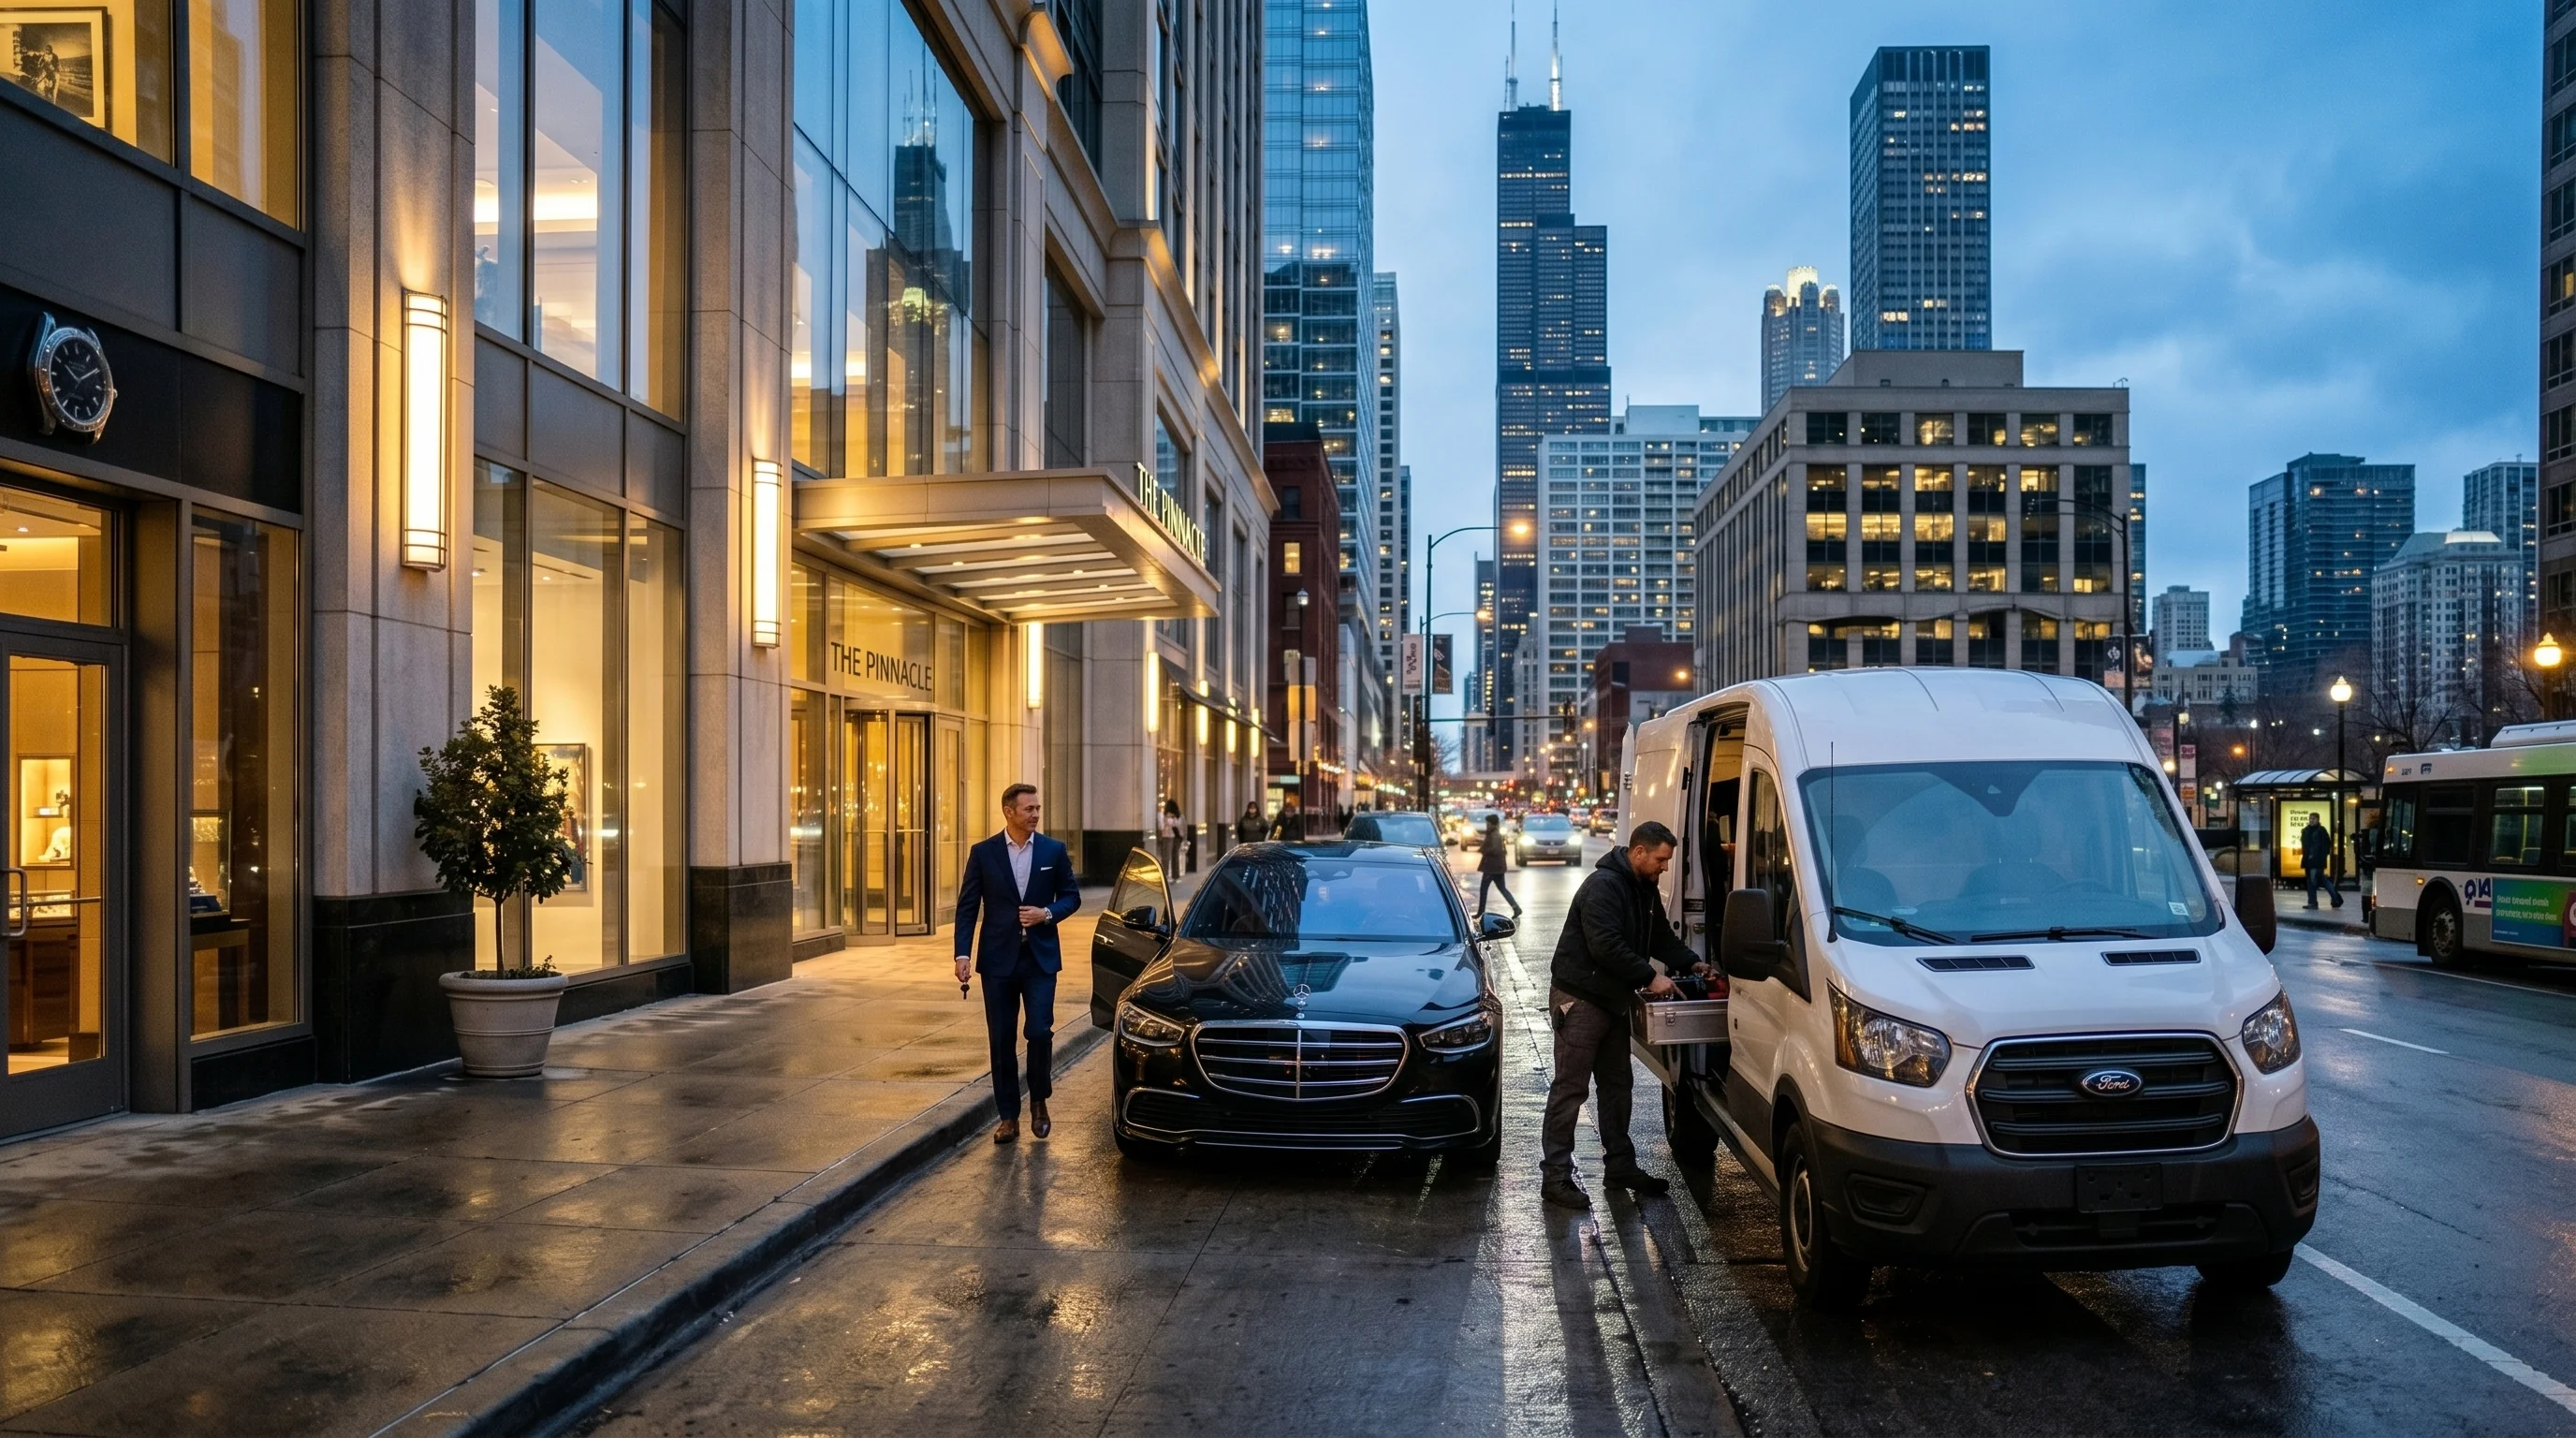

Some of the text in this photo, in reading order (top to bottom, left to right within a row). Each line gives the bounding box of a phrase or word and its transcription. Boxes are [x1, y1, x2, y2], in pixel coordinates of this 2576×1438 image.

[1137, 462, 1206, 568] THE PINNACLE
[830, 641, 932, 692] THE PINNACLE
[2098, 1075, 2130, 1091] Ford
